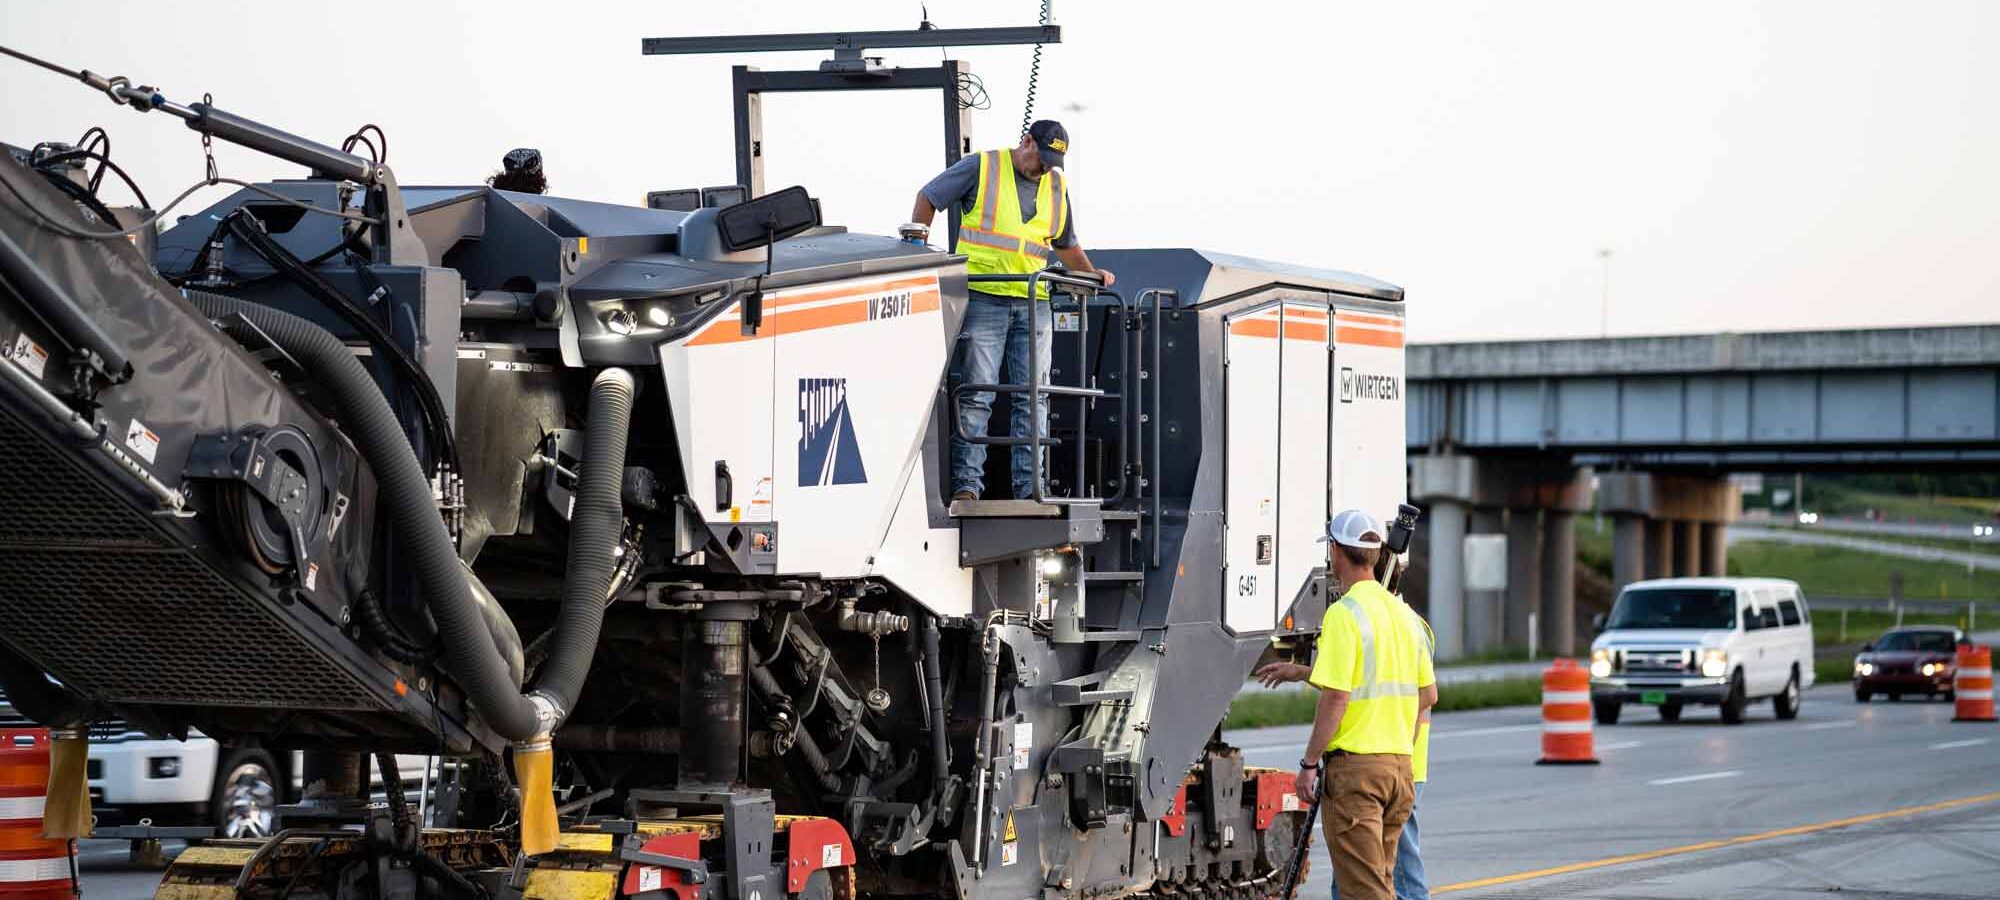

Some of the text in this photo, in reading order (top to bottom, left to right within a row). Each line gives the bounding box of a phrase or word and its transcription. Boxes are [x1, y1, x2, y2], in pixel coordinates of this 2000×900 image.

[869, 292, 911, 321] W 250 Fi
[1355, 374, 1399, 400] WIRTGEN
[1239, 575, 1256, 596] G-451
